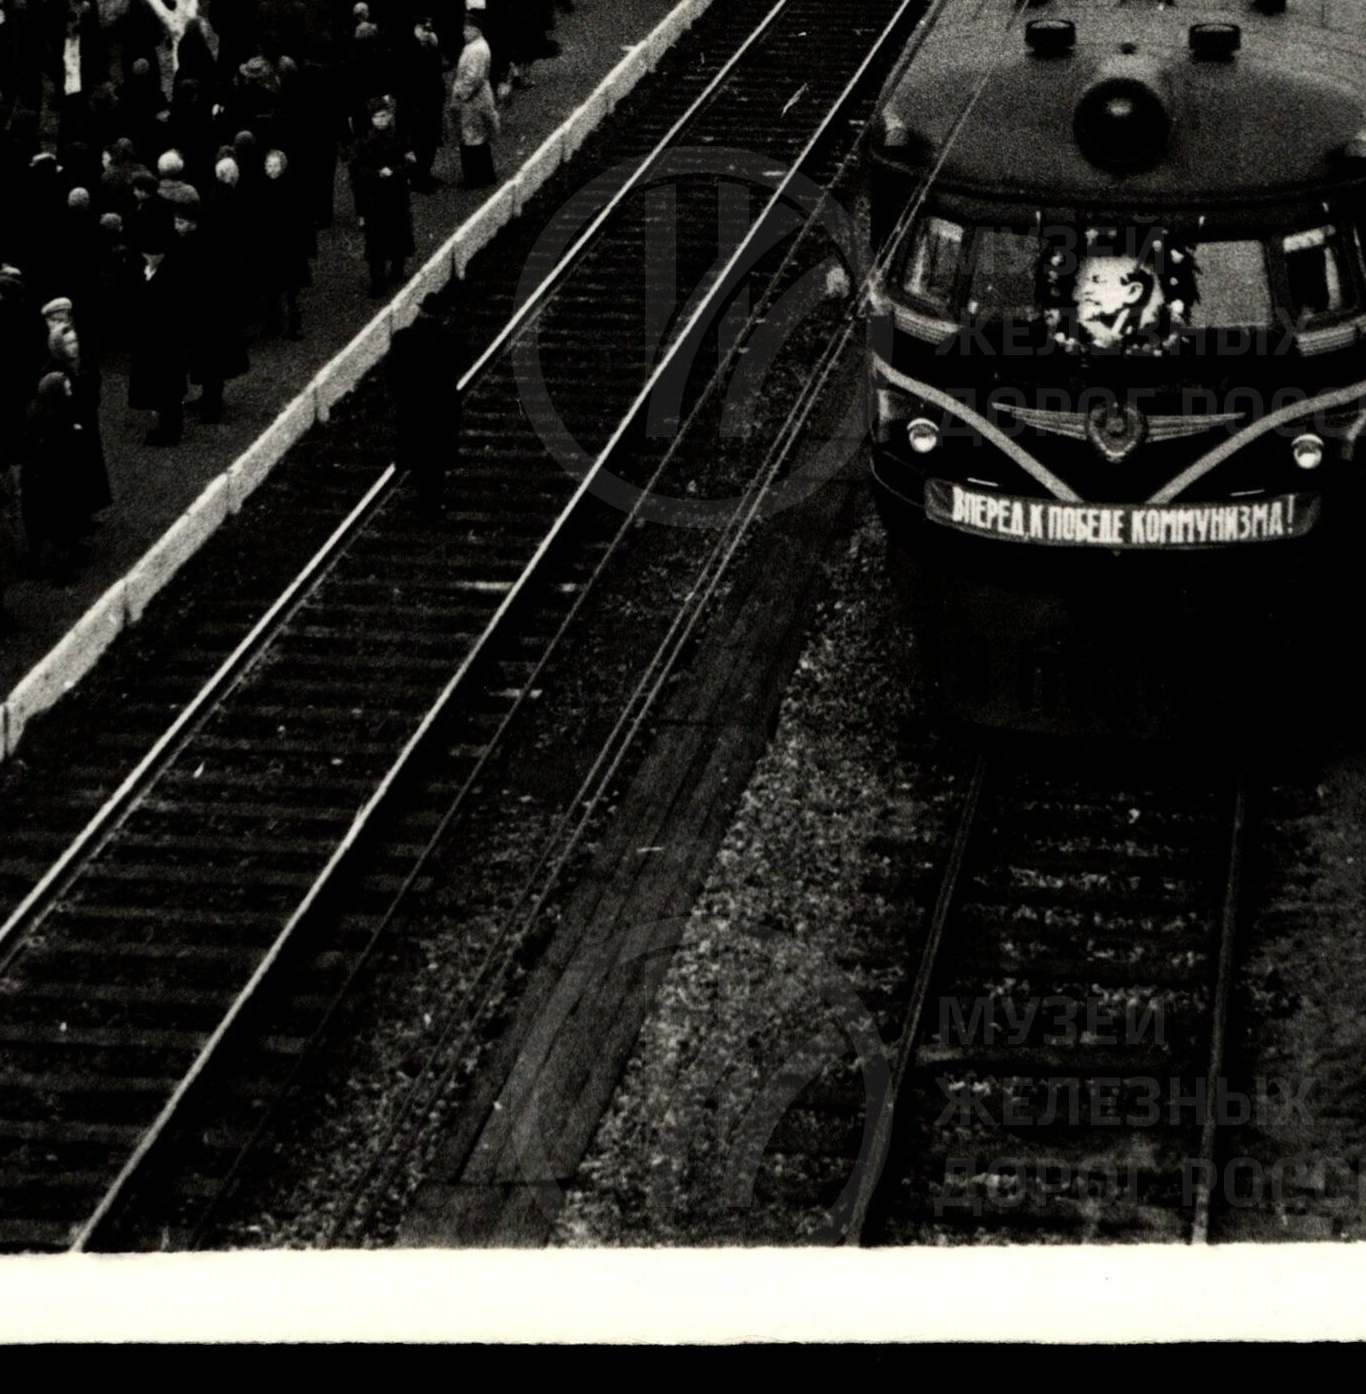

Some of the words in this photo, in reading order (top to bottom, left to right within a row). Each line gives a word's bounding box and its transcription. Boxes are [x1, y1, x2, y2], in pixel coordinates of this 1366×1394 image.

[1030, 504, 1043, 538] К
[1047, 506, 1124, 543] ПОБЕДЕ
[1131, 494, 1295, 543] КОММУНИЗМА!
